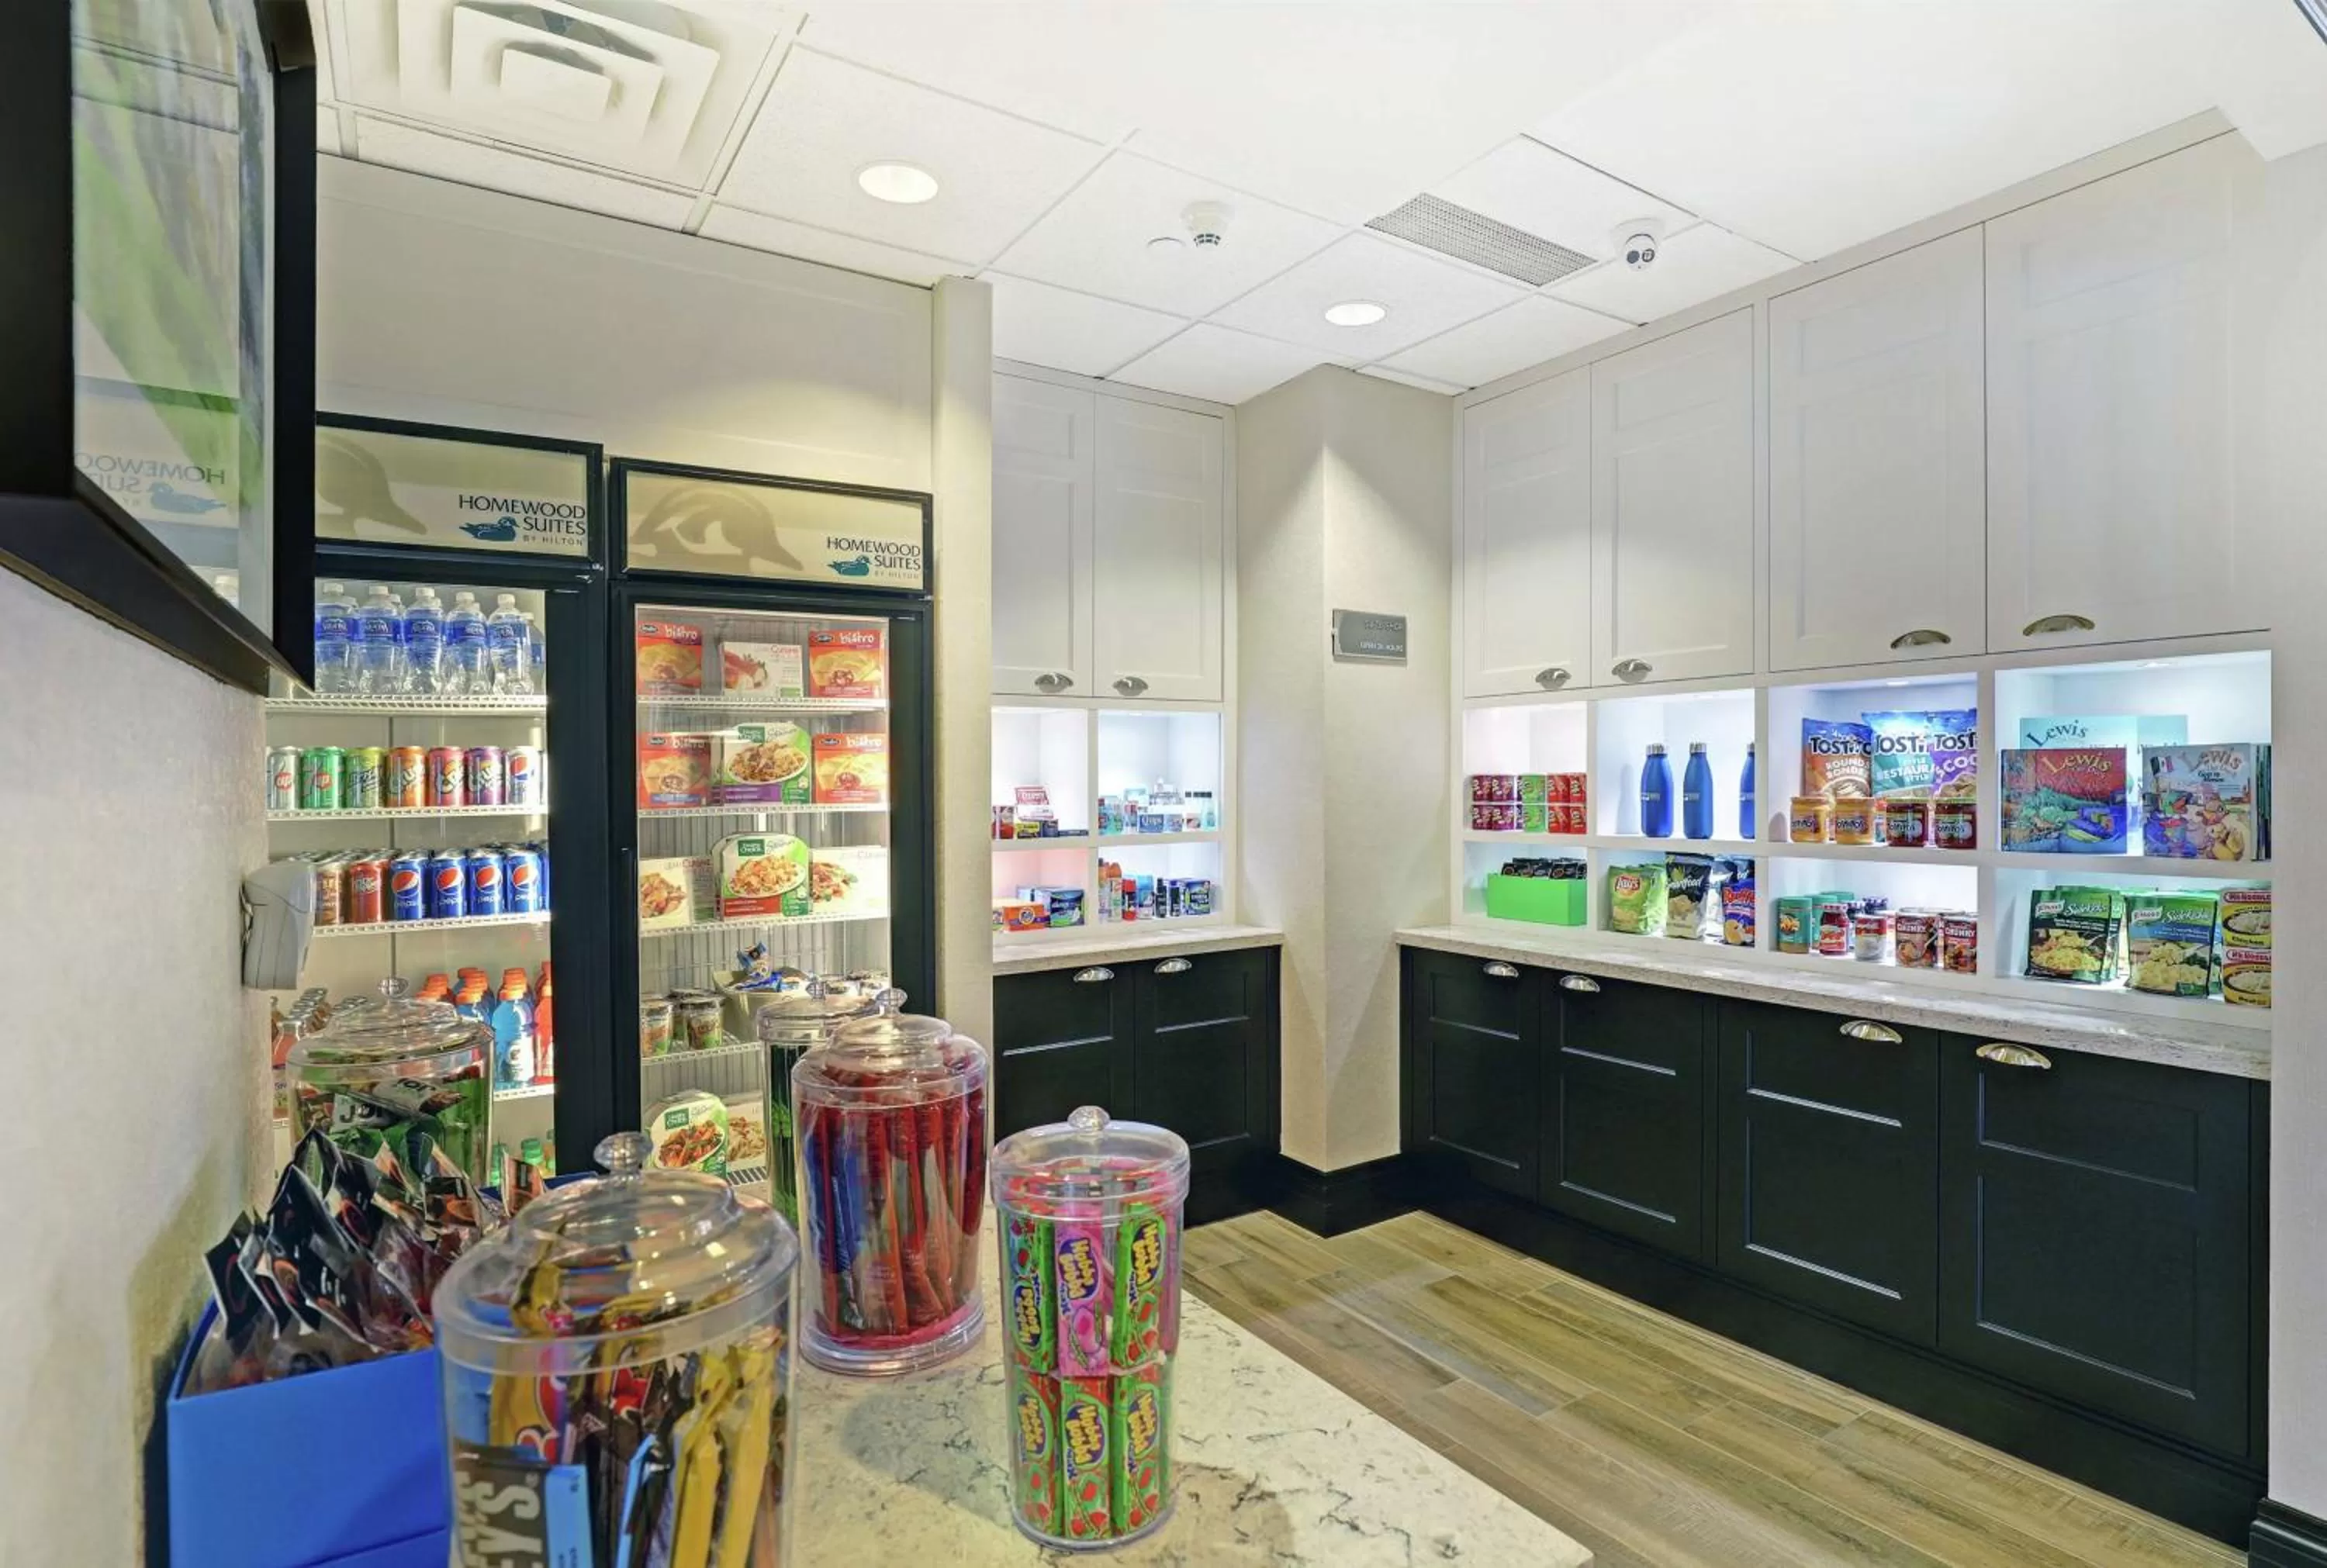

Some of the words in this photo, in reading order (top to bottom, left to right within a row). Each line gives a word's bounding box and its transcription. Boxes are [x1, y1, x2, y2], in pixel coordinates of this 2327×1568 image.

[458, 494, 586, 519] HOMEWOOD
[523, 516, 586, 535] SUITES
[542, 535, 583, 546] HILTON
[827, 536, 921, 557] HOMEWOOD
[874, 554, 921, 571] SUITES
[2025, 720, 2088, 746] Lewis
[2042, 751, 2112, 775] Lewis
[2176, 747, 2242, 772] Lewis
